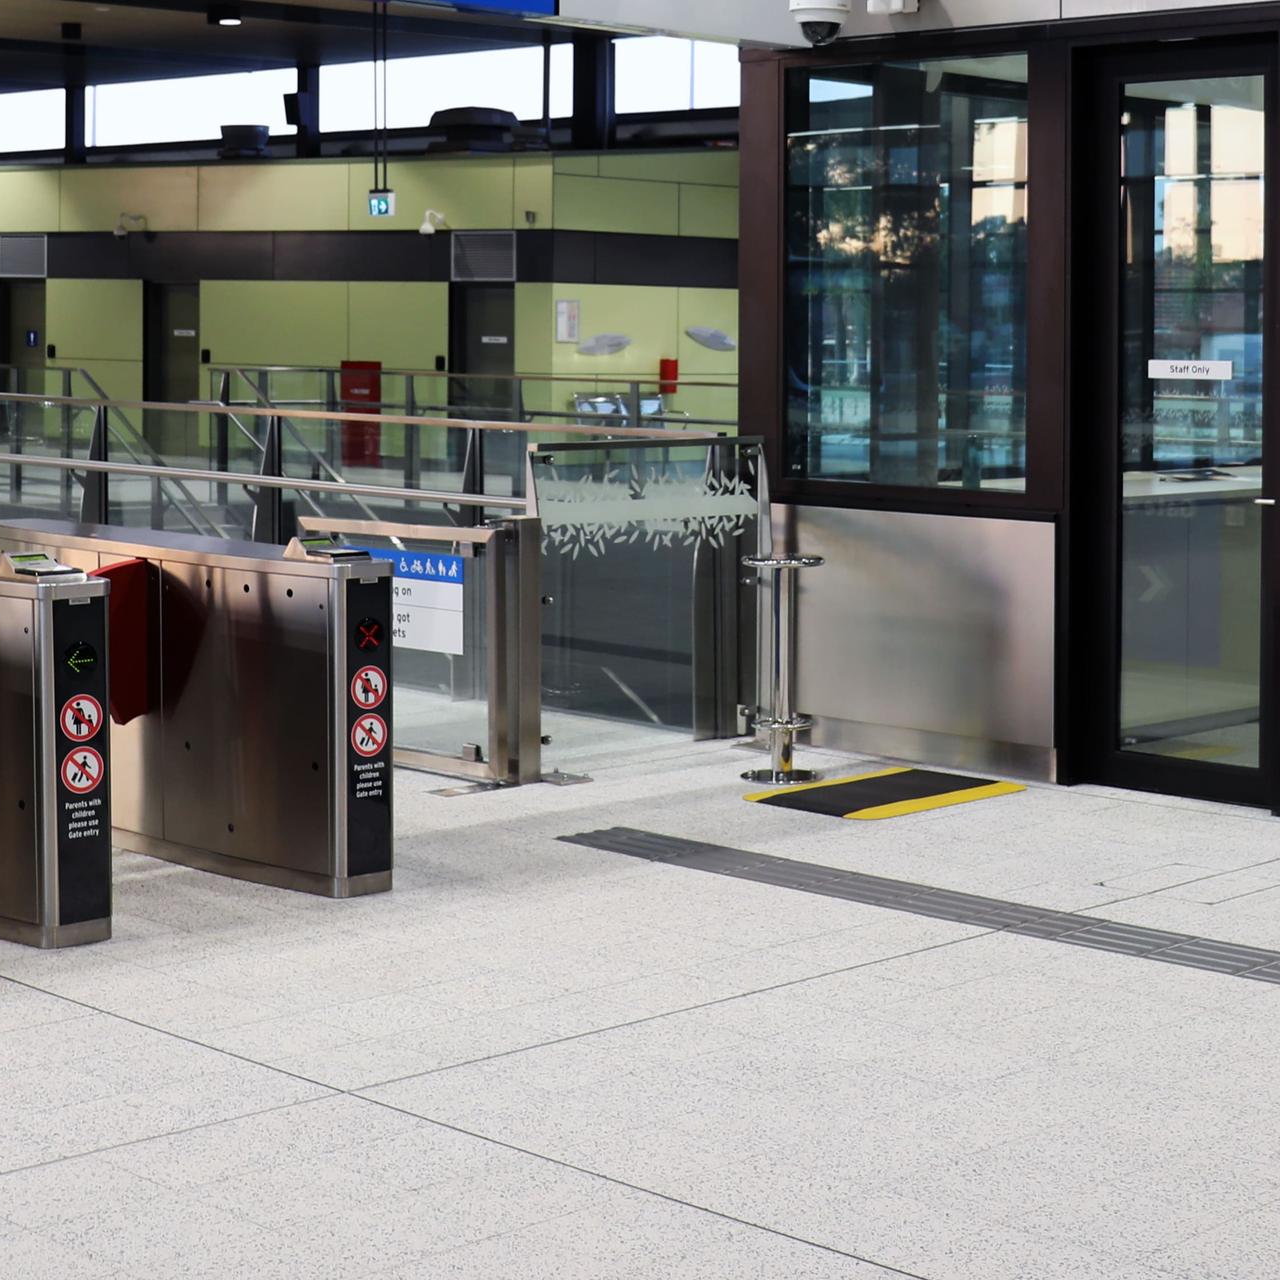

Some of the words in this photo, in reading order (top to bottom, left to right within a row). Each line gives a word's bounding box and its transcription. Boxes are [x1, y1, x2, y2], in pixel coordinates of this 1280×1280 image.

[1170, 365, 1189, 374] Staff
[1192, 365, 1210, 375] Only
[402, 586, 412, 596] on
[396, 612, 410, 624] got
[354, 763, 373, 771] Parents
[360, 772, 379, 780] children
[356, 781, 372, 790] please
[65, 800, 88, 810] Parents
[88, 798, 102, 806] with
[72, 810, 96, 819] children
[68, 821, 88, 830] please
[68, 831, 82, 839] Gate
